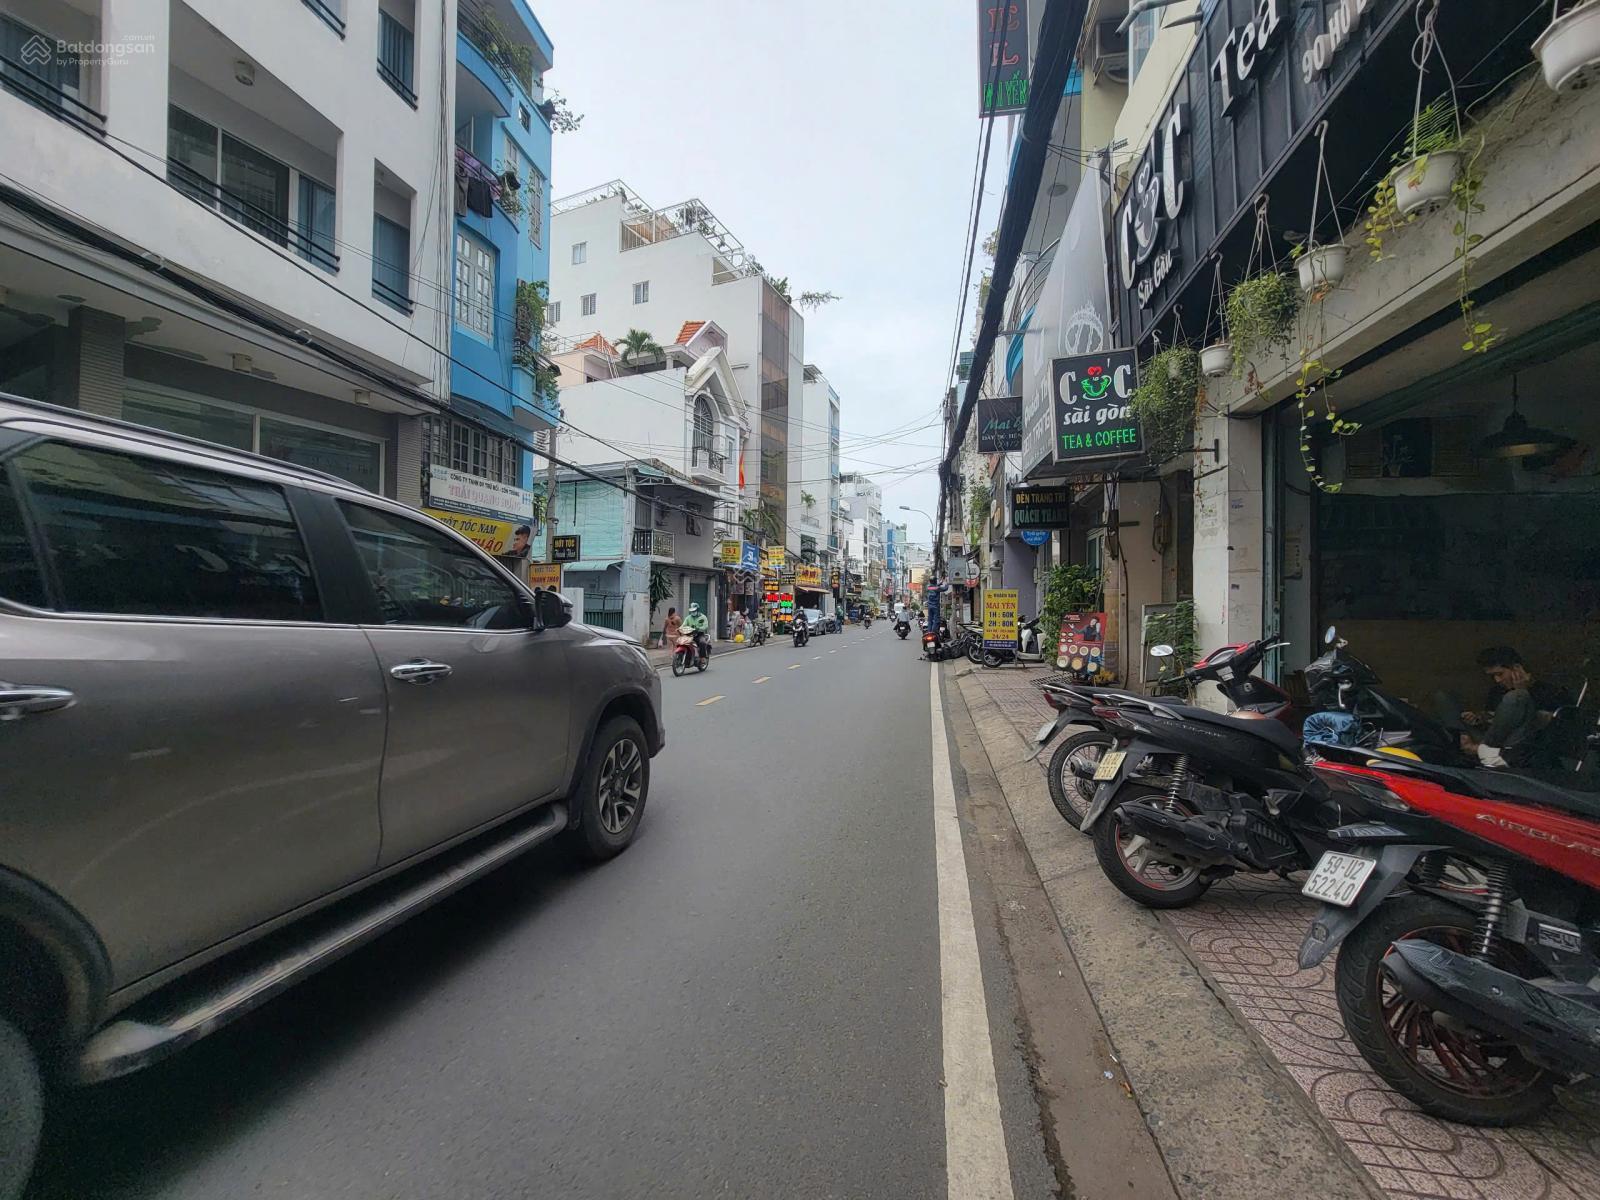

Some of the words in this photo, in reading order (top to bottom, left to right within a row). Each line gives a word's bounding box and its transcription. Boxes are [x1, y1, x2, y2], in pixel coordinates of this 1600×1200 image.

[1210, 0, 1280, 117] Tea
[1302, 34, 1325, 84] 90
[1063, 405, 1091, 425] sài
[1062, 433, 1083, 449] TEA
[1085, 432, 1092, 447] &
[1095, 428, 1137, 447] COFFEE
[460, 518, 478, 532] TÓC
[477, 522, 498, 535] NAM
[1322, 855, 1366, 880] 59-U2
[1308, 874, 1356, 901] 522.40
